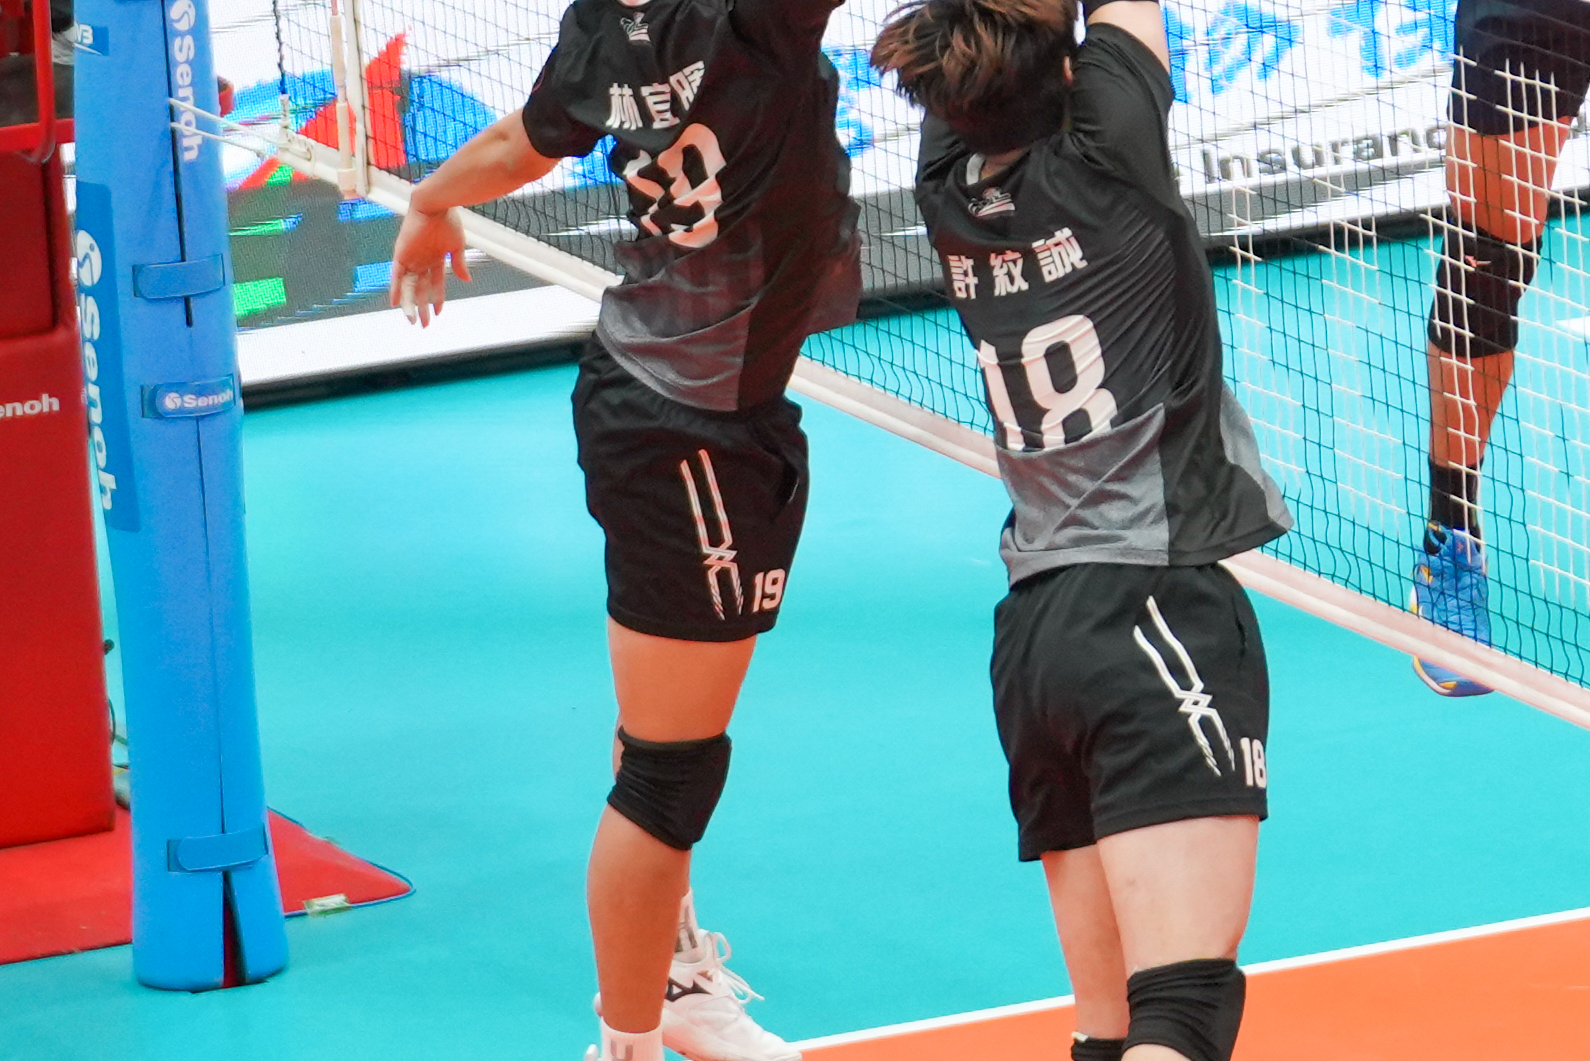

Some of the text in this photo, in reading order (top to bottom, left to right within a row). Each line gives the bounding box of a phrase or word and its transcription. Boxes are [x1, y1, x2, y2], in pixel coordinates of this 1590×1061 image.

[172, 34, 203, 162] Senoh
[947, 226, 1088, 300] 許紋誠
[79, 292, 117, 510] Senoh
[183, 390, 234, 409] Senoh
[974, 314, 1118, 451] 18
[752, 568, 786, 613] 19
[1240, 736, 1267, 788] 18
